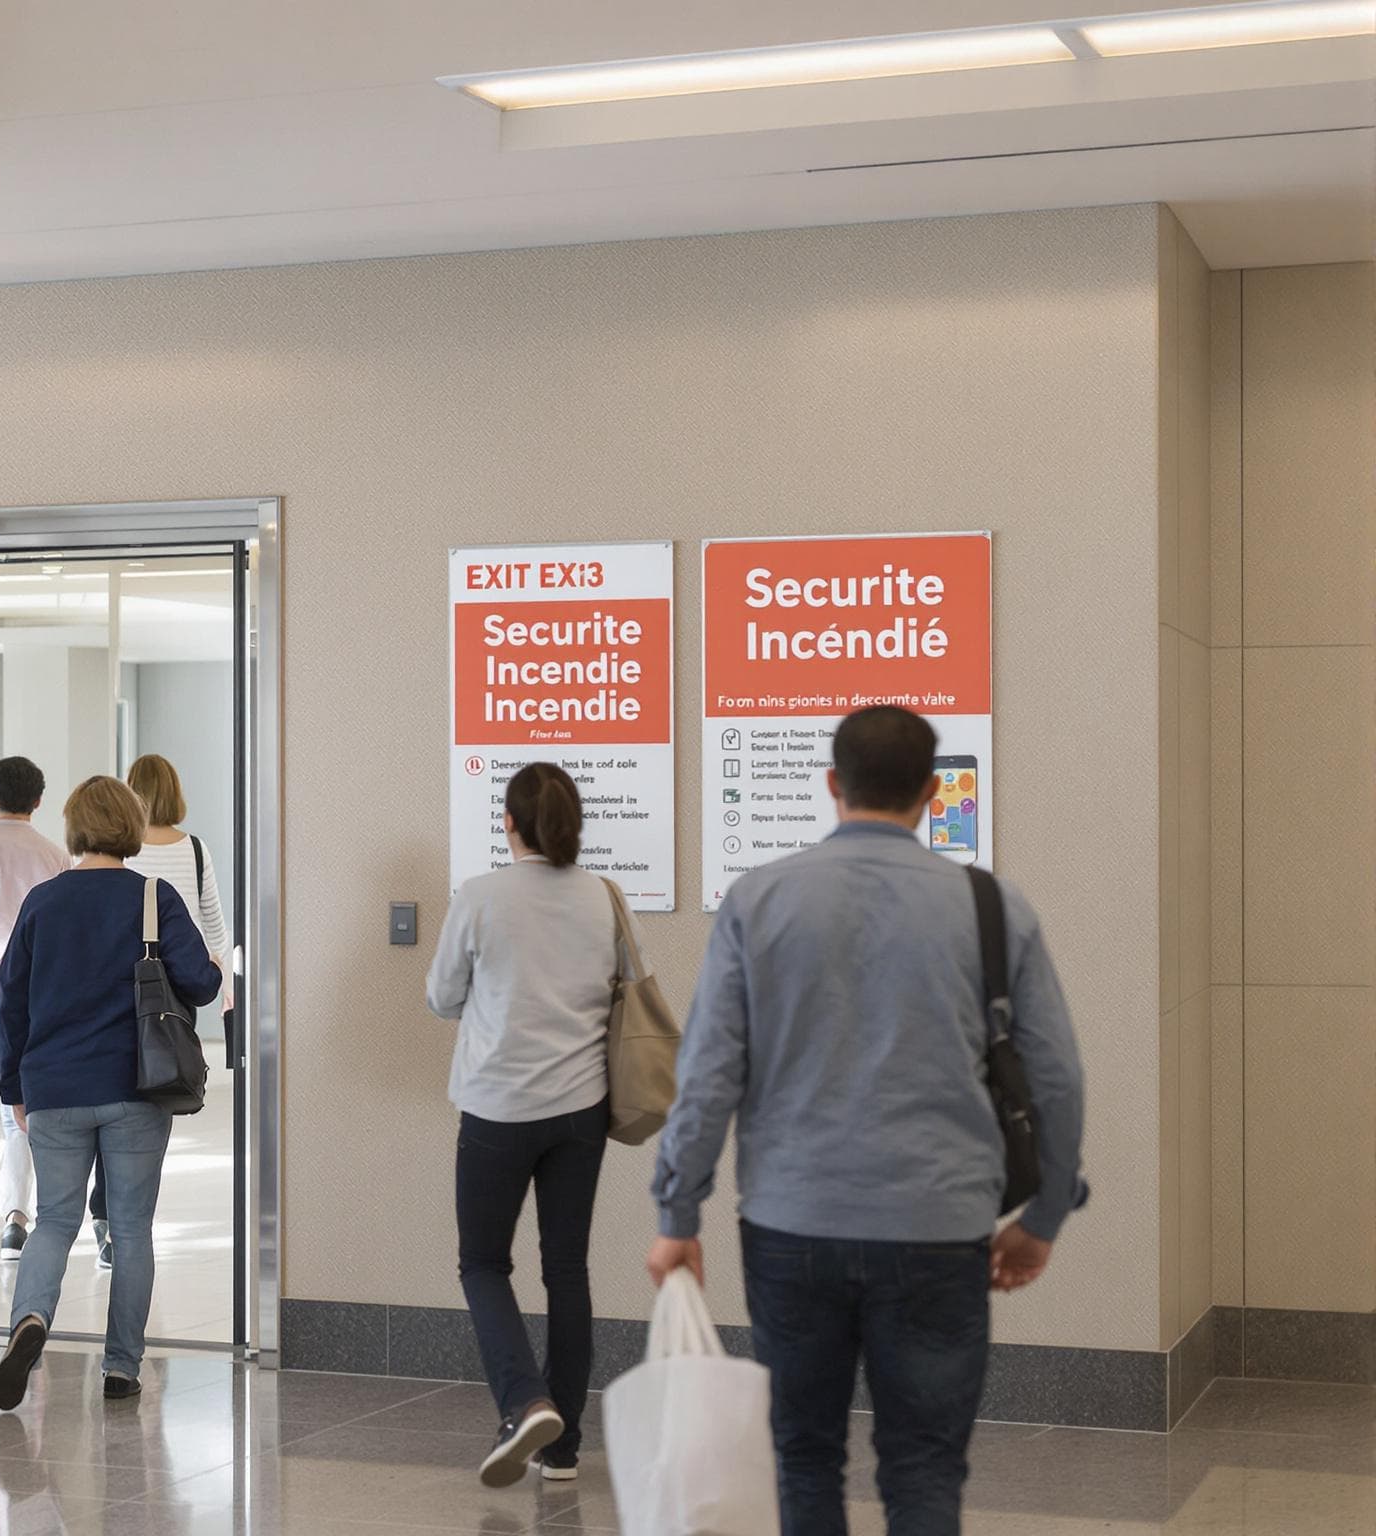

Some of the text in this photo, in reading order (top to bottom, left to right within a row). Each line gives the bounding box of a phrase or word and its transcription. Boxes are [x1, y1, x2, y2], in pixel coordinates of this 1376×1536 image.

[467, 563, 530, 589] EXIT
[746, 565, 944, 607] Securite
[484, 612, 641, 646] Securite
[748, 618, 947, 659] Incéndié
[487, 653, 640, 684] Incendie
[486, 690, 640, 721] Incendie
